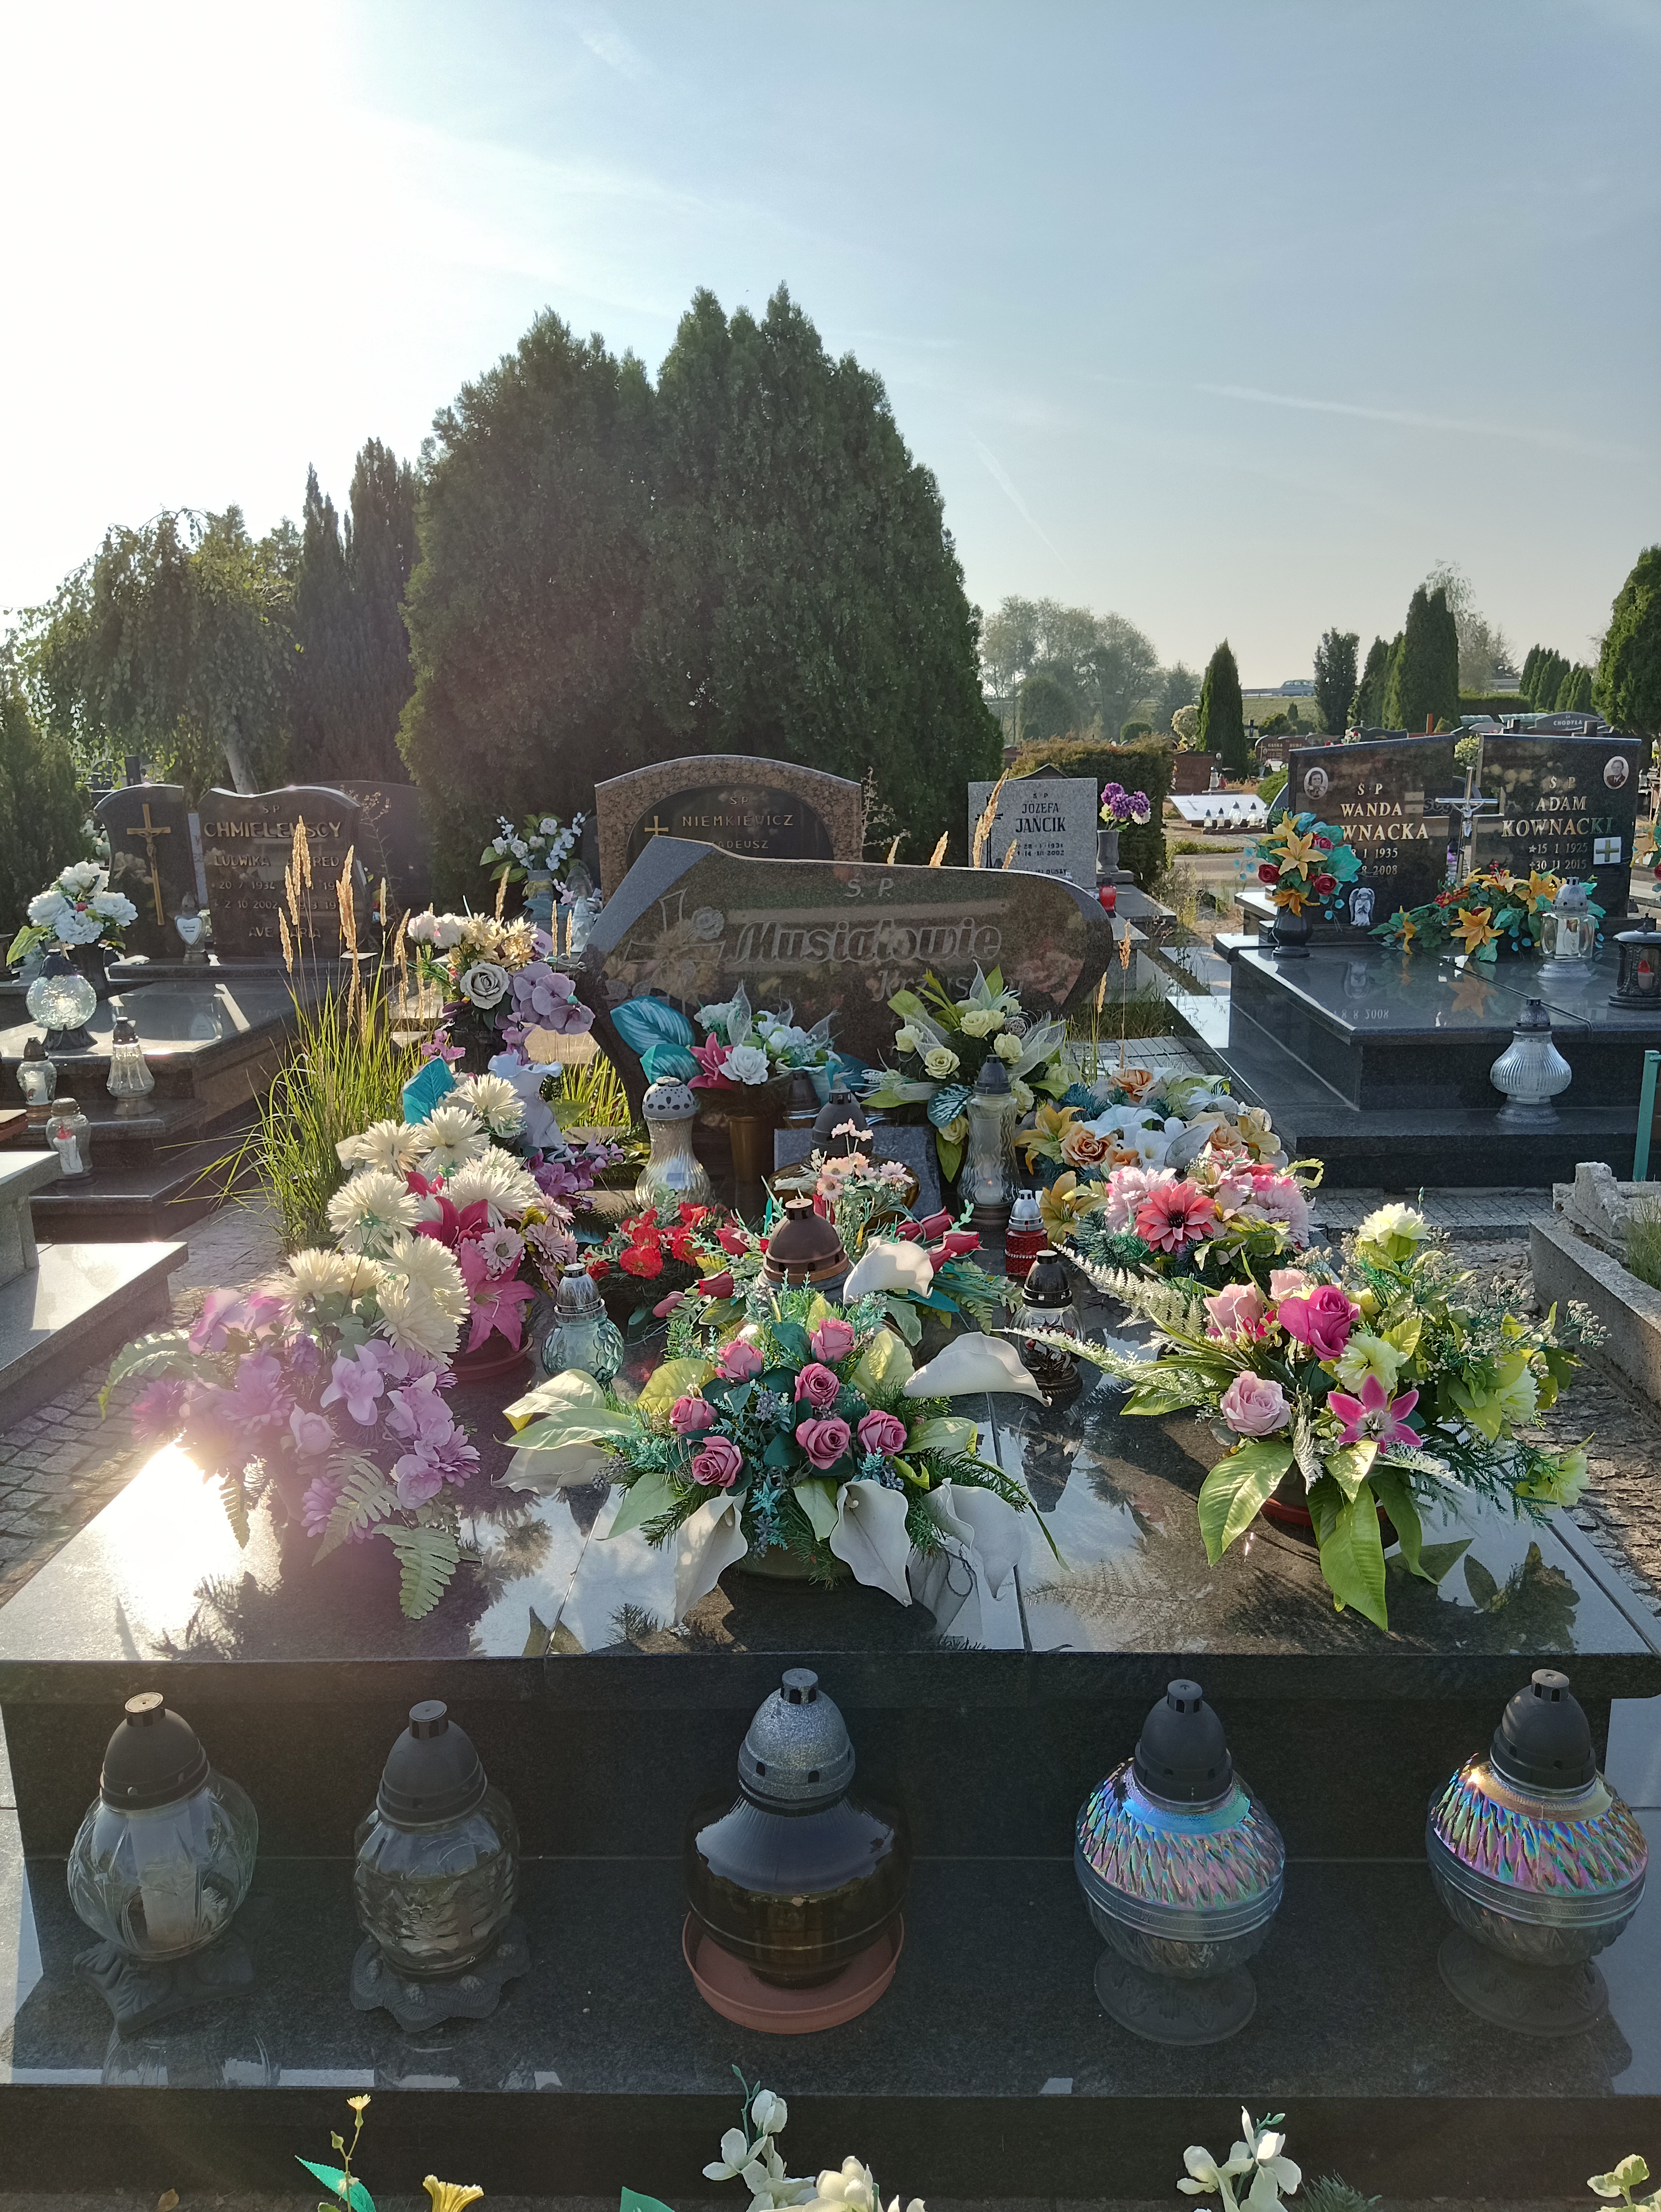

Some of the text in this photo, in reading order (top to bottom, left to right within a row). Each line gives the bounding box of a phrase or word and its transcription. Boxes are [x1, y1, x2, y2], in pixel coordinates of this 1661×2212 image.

[1022, 800, 1059, 813] JÓZEFA
[1340, 802, 1402, 817] WANDA
[1535, 796, 1587, 811] ADAM
[683, 815, 793, 827] NIEMKIEWICZ
[1015, 815, 1066, 833] JAŃCIK
[1501, 817, 1614, 837] KOWNACKI
[204, 821, 341, 838] CHMIELESCY
[1375, 848, 1398, 859] 1935
[1538, 843, 1548, 854] 15
[1566, 842, 1588, 853] 1925
[214, 856, 271, 866] LUDWIKA
[1536, 860, 1547, 870] 30
[1565, 860, 1587, 870] 2015
[1373, 865, 1397, 876] 2008
[253, 901, 278, 909] 2002
[249, 927, 321, 938] AVE ARIA
